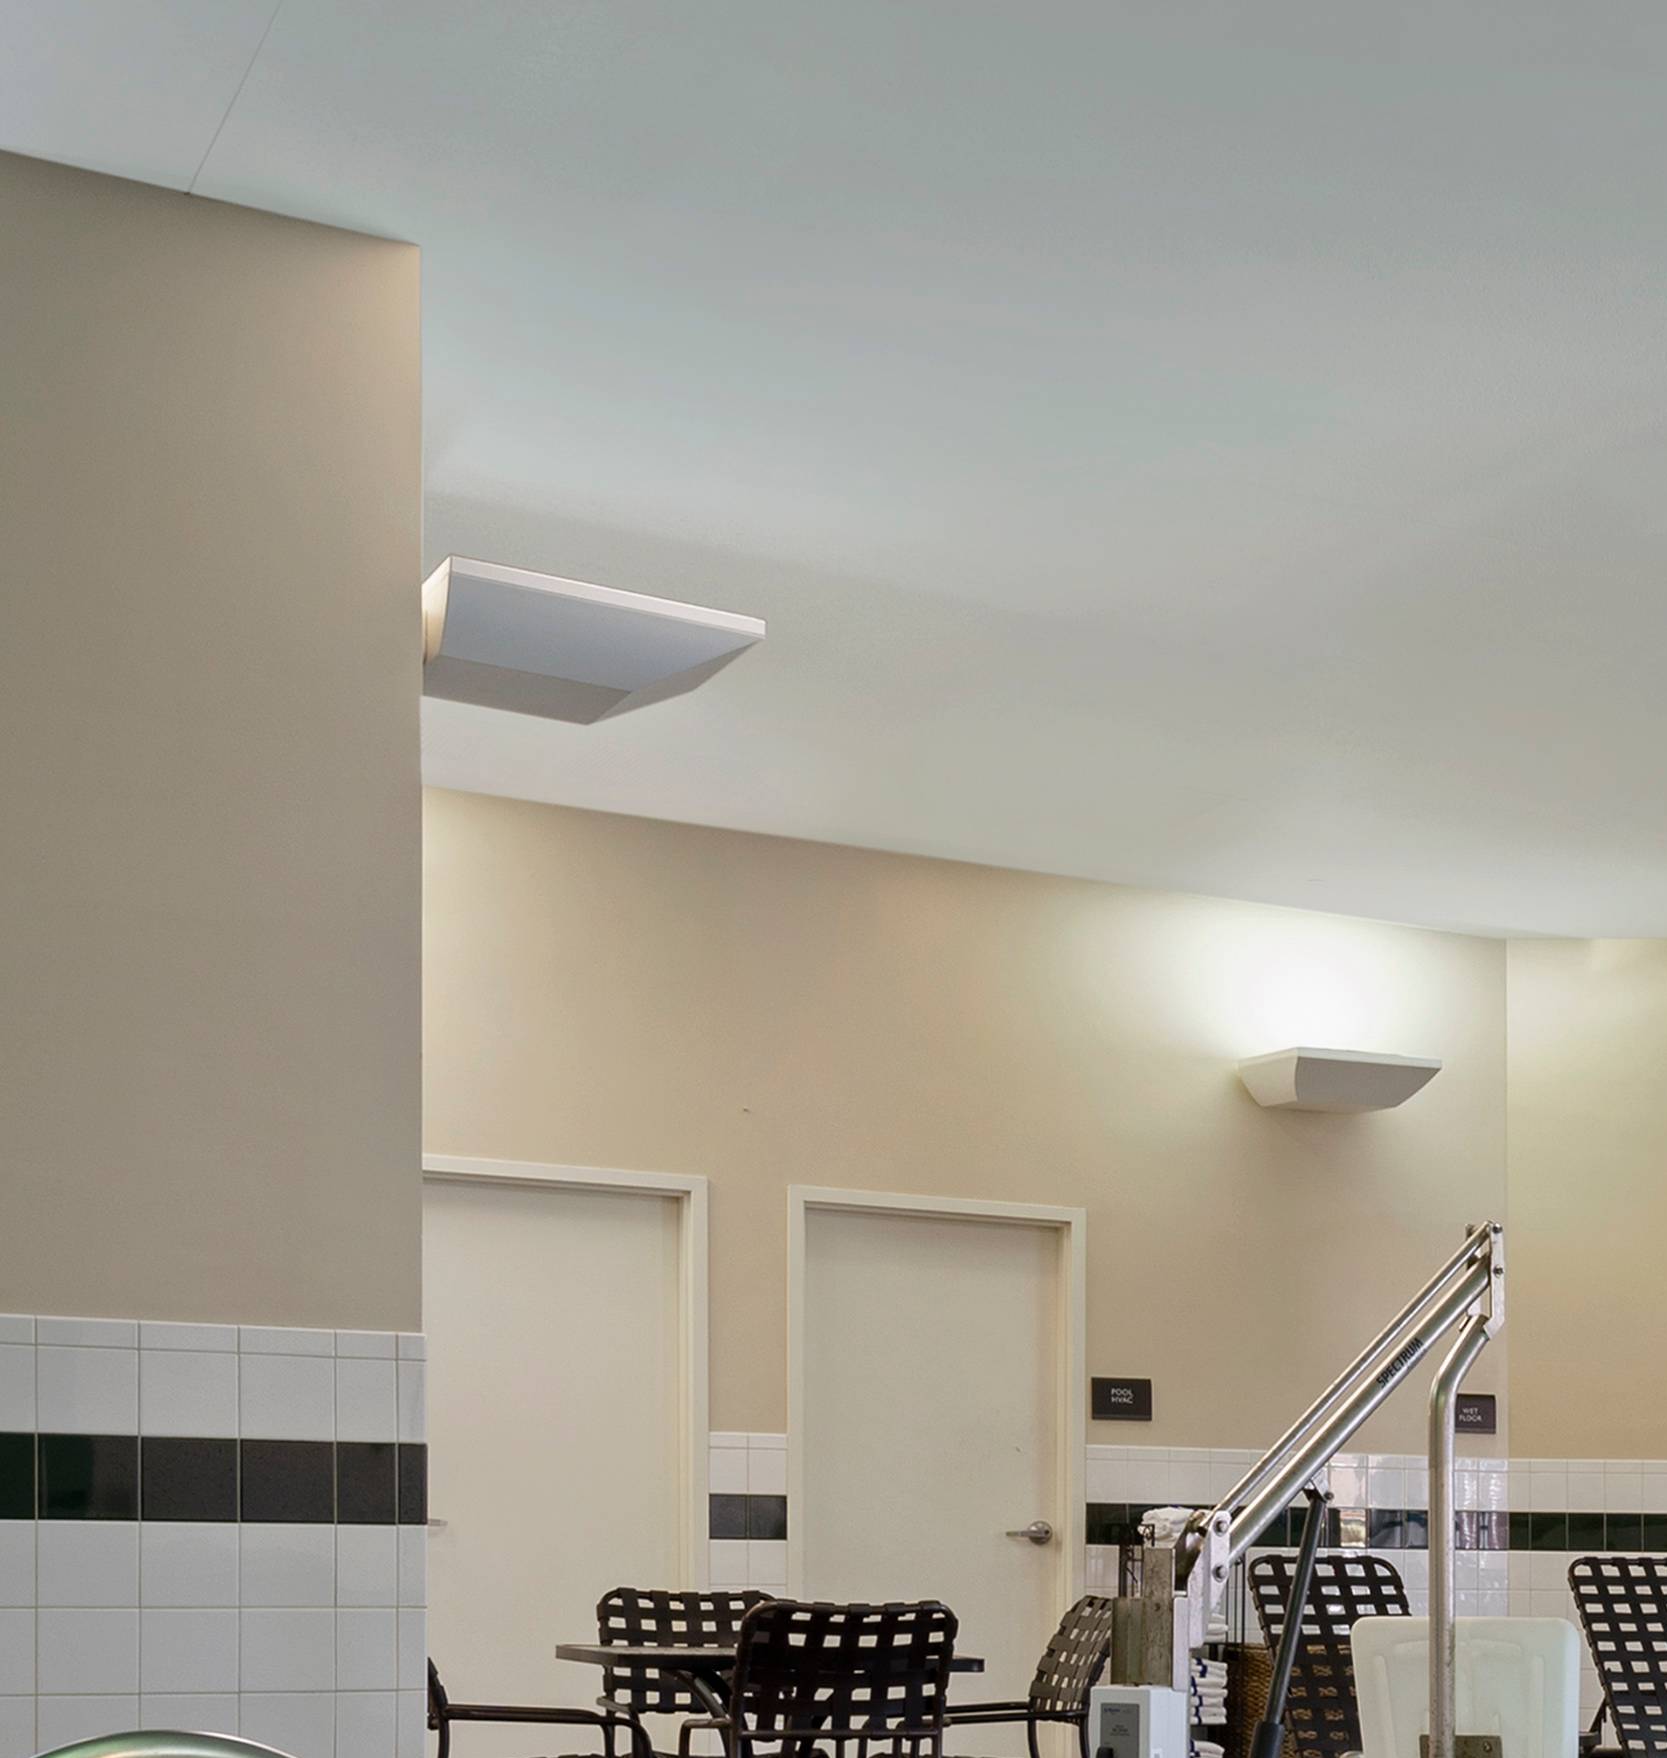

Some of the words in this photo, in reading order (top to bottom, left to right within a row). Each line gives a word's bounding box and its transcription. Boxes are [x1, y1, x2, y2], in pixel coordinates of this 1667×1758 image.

[1376, 1337, 1423, 1388] SPECTRUM
[1111, 1388, 1133, 1396] POOL
[1111, 1396, 1133, 1404] HVAC
